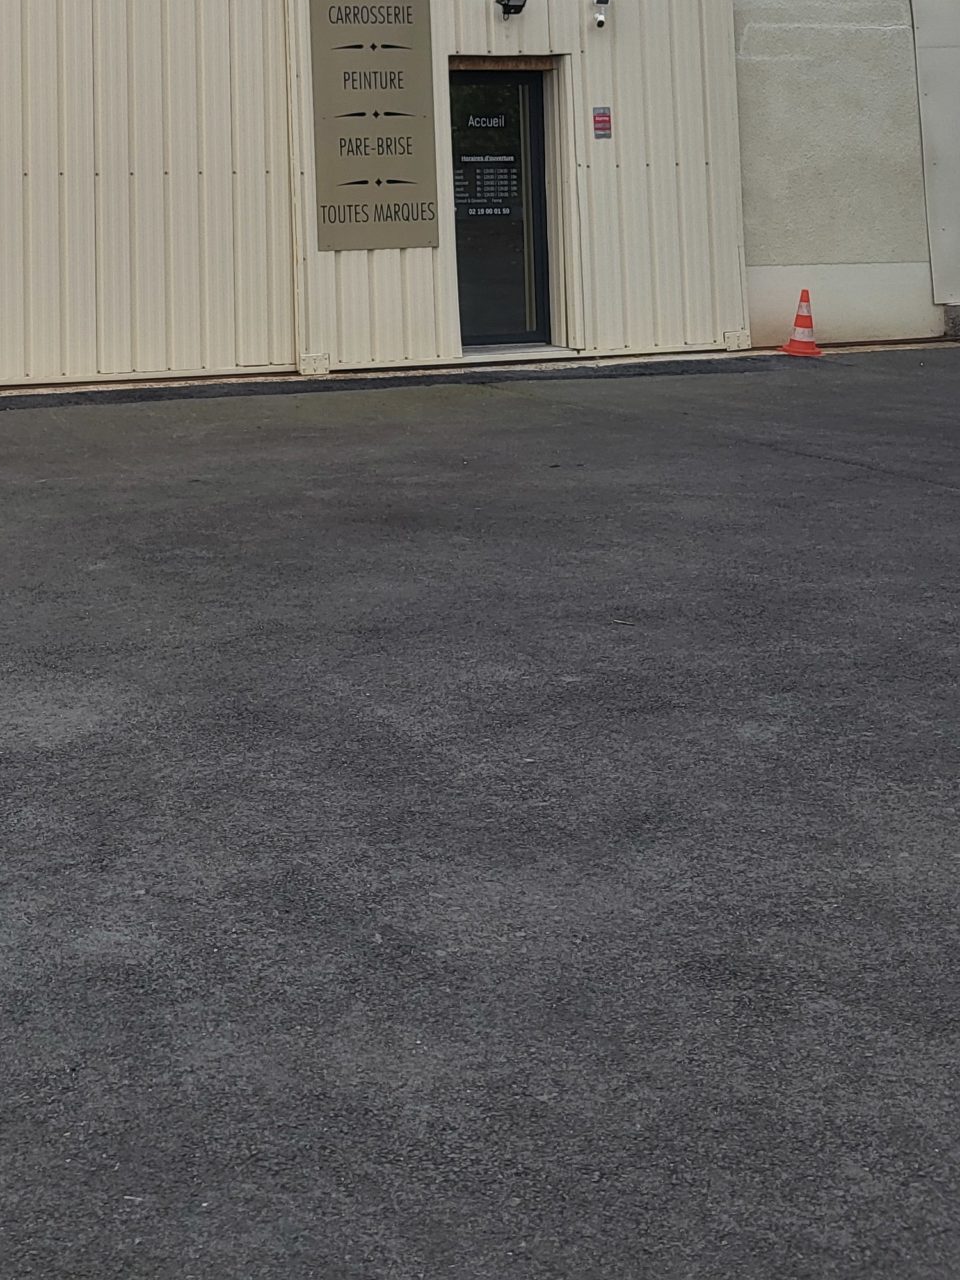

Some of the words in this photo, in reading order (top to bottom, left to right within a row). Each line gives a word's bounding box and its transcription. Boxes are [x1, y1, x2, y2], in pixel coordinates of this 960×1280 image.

[327, 4, 415, 25] CARROSSERIE
[342, 70, 406, 90] PEINTURE
[467, 114, 506, 128] Accueil
[339, 136, 413, 156] PARE-BRISE
[320, 203, 370, 224] TOUTES
[373, 201, 436, 223] MARQUES
